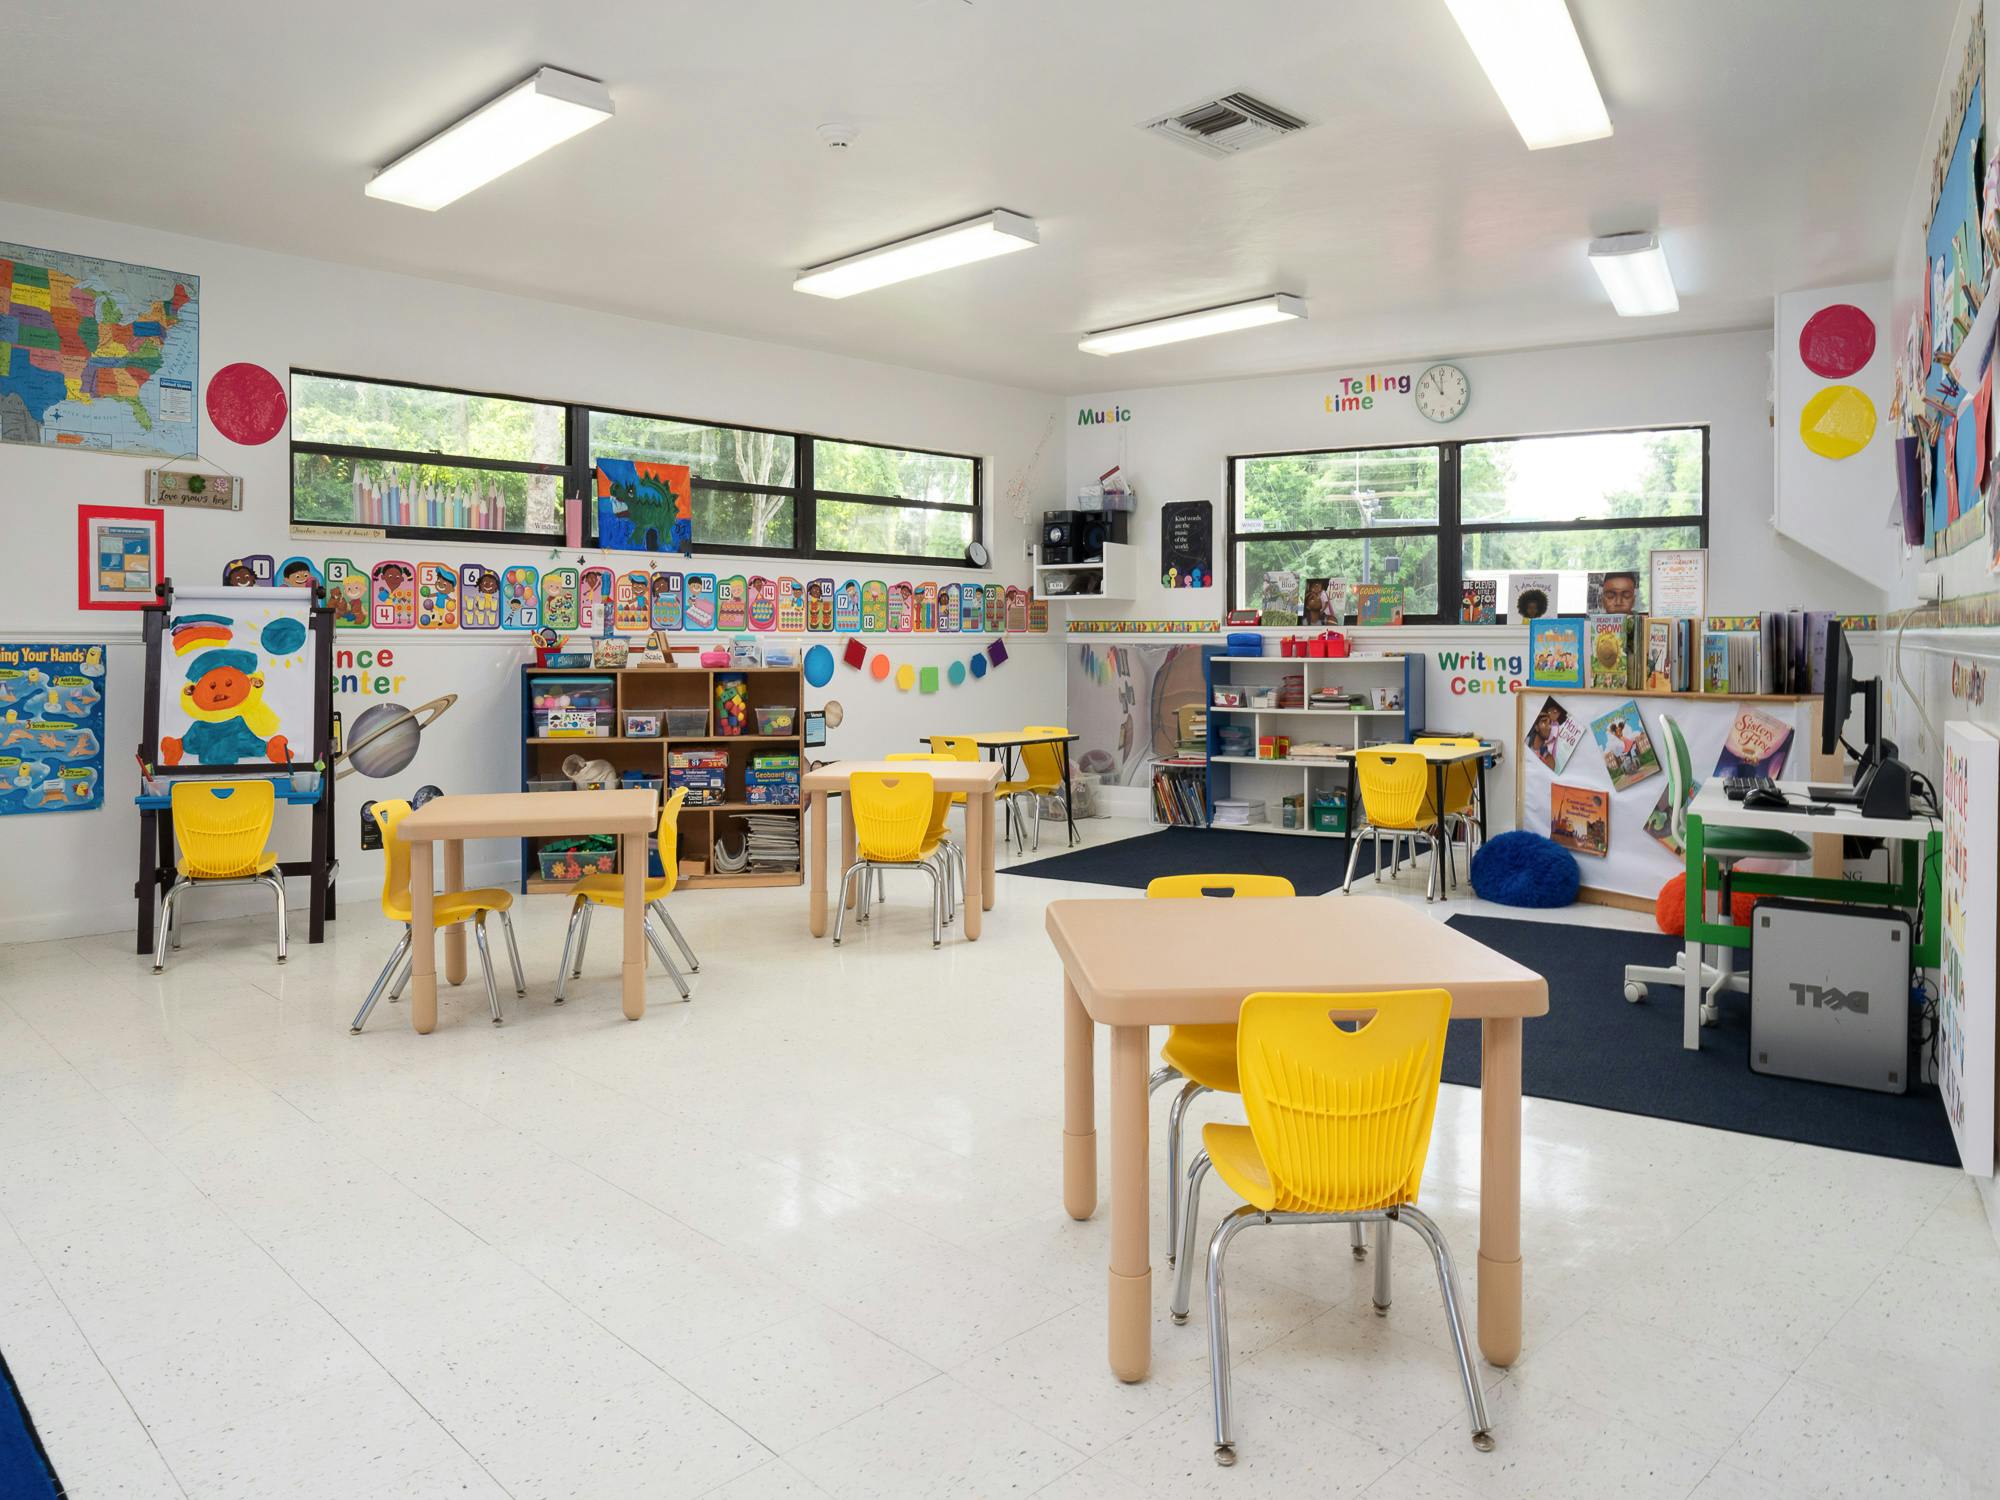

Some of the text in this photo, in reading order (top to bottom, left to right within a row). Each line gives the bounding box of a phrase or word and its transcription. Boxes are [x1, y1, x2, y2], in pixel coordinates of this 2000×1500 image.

[1340, 373, 1411, 395] Telling
[1325, 394, 1374, 412] time
[1078, 406, 1131, 426] Music
[159, 490, 178, 500] Love
[181, 494, 208, 504] grows
[534, 522, 558, 530] Window
[259, 563, 263, 576] 1
[334, 566, 342, 578] 3
[426, 570, 433, 581] 5
[468, 571, 476, 583] 6
[564, 574, 572, 585] 8
[672, 579, 679, 590] 11
[703, 580, 712, 591] 12
[782, 581, 791, 592] 15
[823, 583, 831, 594] 16
[1329, 581, 1345, 590] Hair
[1360, 585, 1394, 595] GOODNIGHT
[1474, 580, 1496, 589] CLEVER
[620, 586, 631, 599] 10
[721, 587, 730, 597] 13
[764, 586, 774, 598] 14
[925, 587, 934, 597] 20
[965, 588, 973, 597] 22
[986, 590, 995, 598] 23
[1329, 590, 1345, 600] Love
[838, 597, 847, 607] 17
[1016, 596, 1024, 604] 24
[1380, 595, 1399, 603] MOON
[1481, 594, 1496, 603] FOX
[381, 608, 389, 620] 4
[526, 612, 533, 623] 7
[865, 617, 873, 627] 18
[902, 618, 909, 627] 19
[940, 618, 947, 627] 21
[0, 647, 84, 666] ing Your Hands
[337, 649, 393, 669] nce
[644, 652, 662, 660] Scale
[1438, 651, 1522, 675] Writing
[332, 671, 407, 695] enter
[1451, 675, 1522, 695] Cente
[25, 720, 31, 730] 3
[1564, 717, 1581, 736] Hair
[1735, 714, 1773, 741] Sisters
[1559, 727, 1576, 746] Love
[1738, 730, 1770, 753] First
[755, 771, 785, 779] Geoboard
[1789, 982, 1869, 1015] DELL
